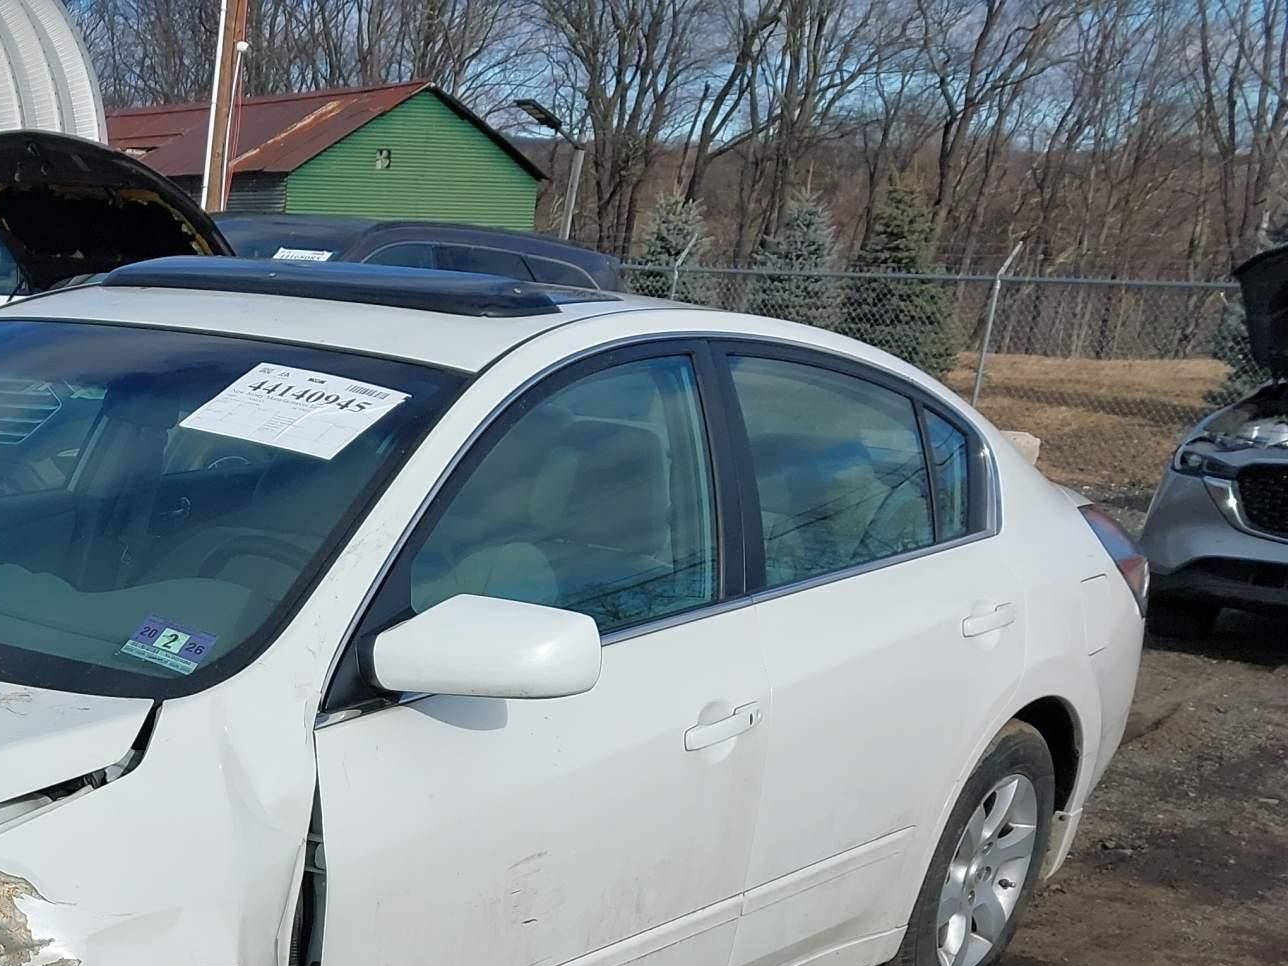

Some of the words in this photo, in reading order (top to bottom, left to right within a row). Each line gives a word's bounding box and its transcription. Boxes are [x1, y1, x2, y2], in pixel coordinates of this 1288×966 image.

[248, 379, 373, 413] 44140945
[139, 626, 158, 639] 20
[162, 633, 179, 649] 2
[185, 642, 205, 655] 26
